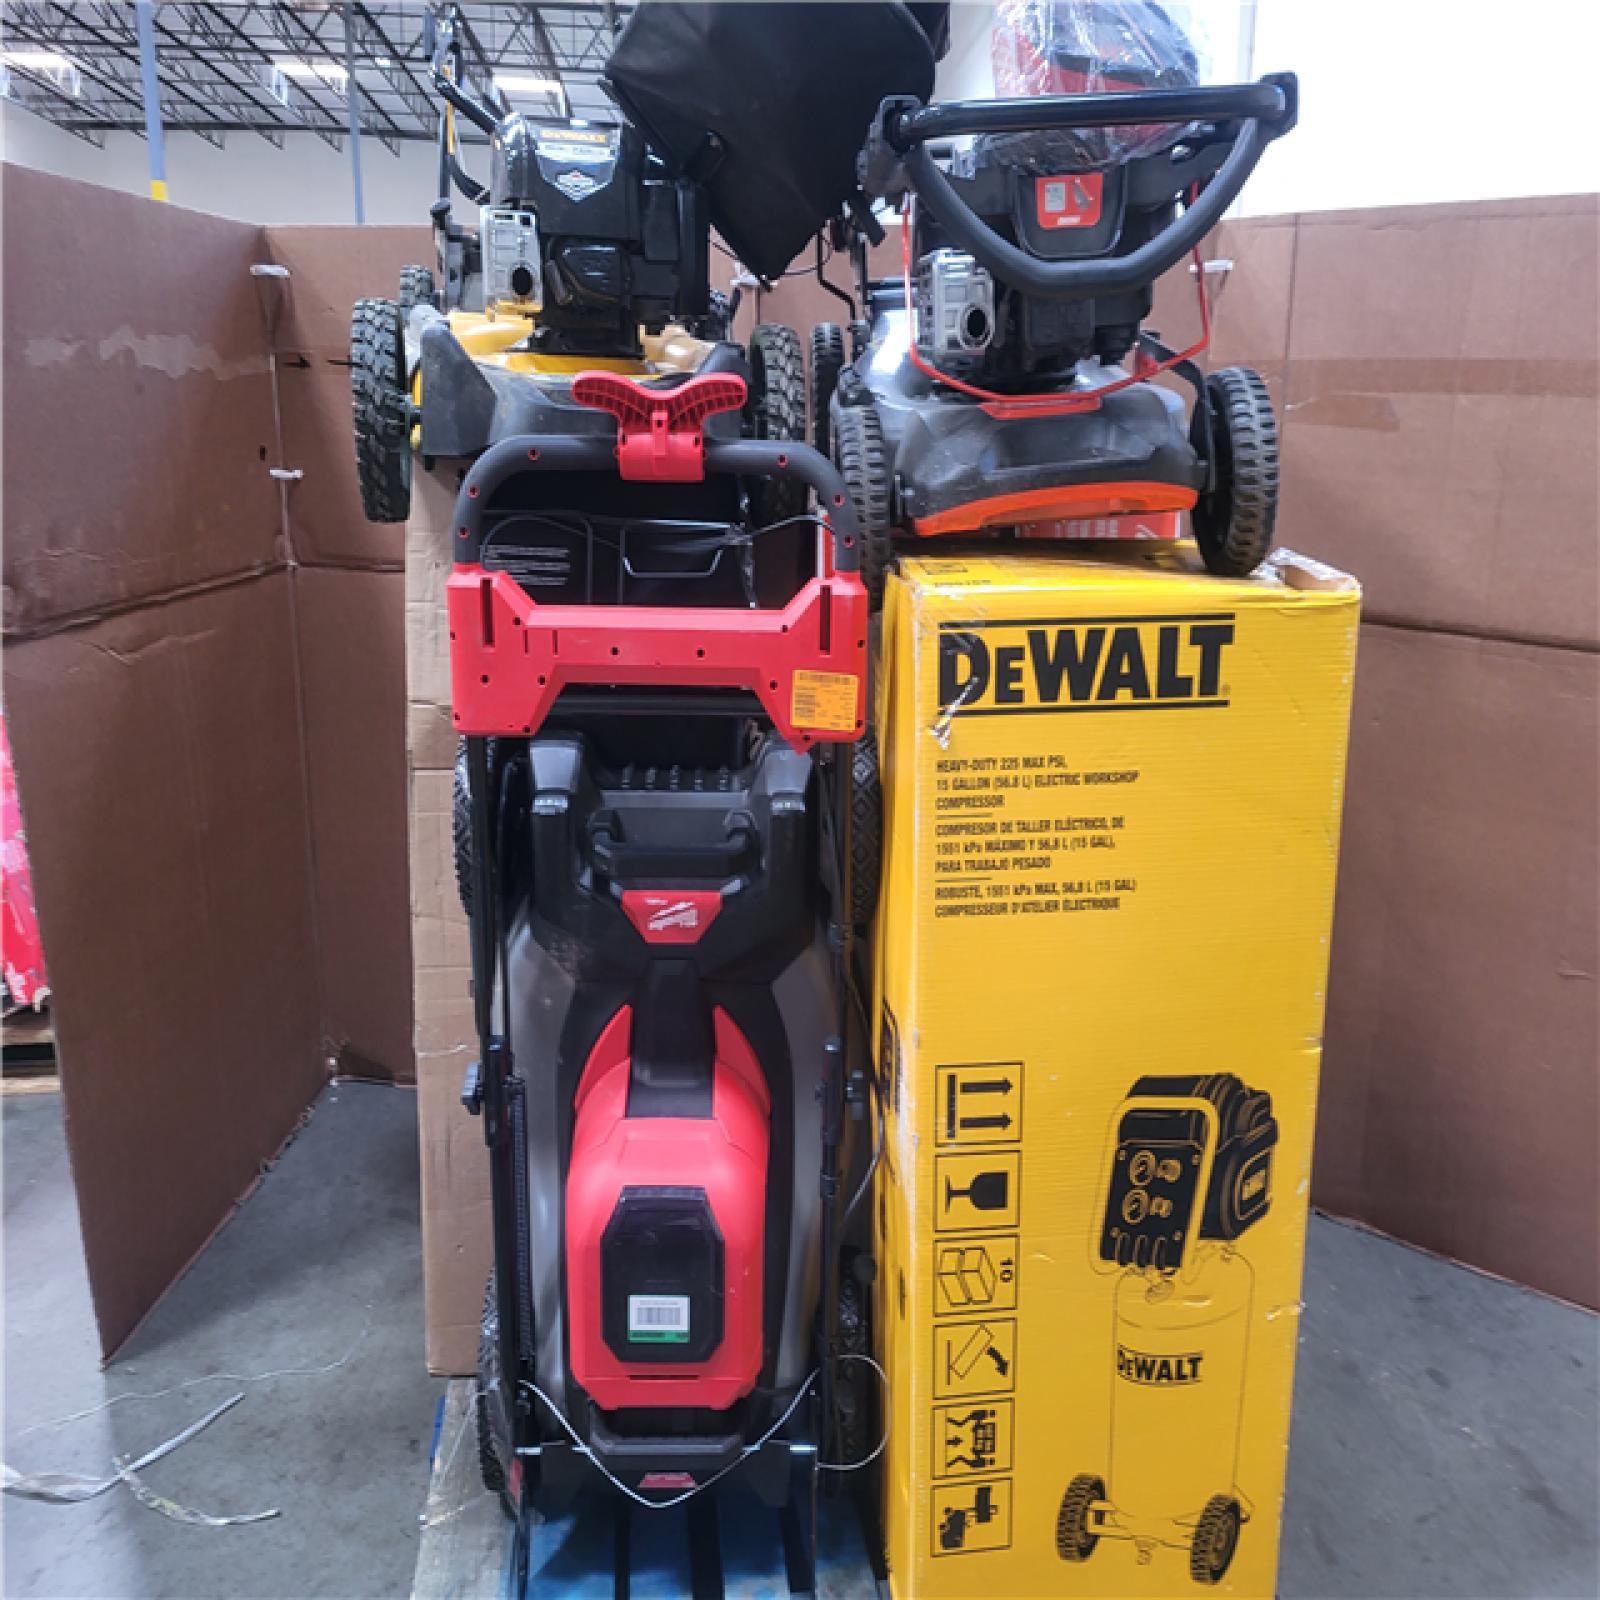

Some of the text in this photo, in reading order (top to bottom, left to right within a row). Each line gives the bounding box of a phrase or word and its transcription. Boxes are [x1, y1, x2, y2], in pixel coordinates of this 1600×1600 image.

[1022, 757, 1045, 769] MAX
[952, 778, 990, 790] GALLON
[1035, 774, 1080, 788] ELECTRIC
[1084, 771, 1139, 785] WORKSHOP
[935, 796, 1004, 810] COMPRESSOR
[935, 823, 997, 836] COMPRESOR
[1000, 822, 1013, 833] DE
[1016, 820, 1050, 832] TALLER
[935, 857, 1051, 873] PARA TRABAJO PESADO
[935, 903, 1008, 917] COMPRESSEUR
